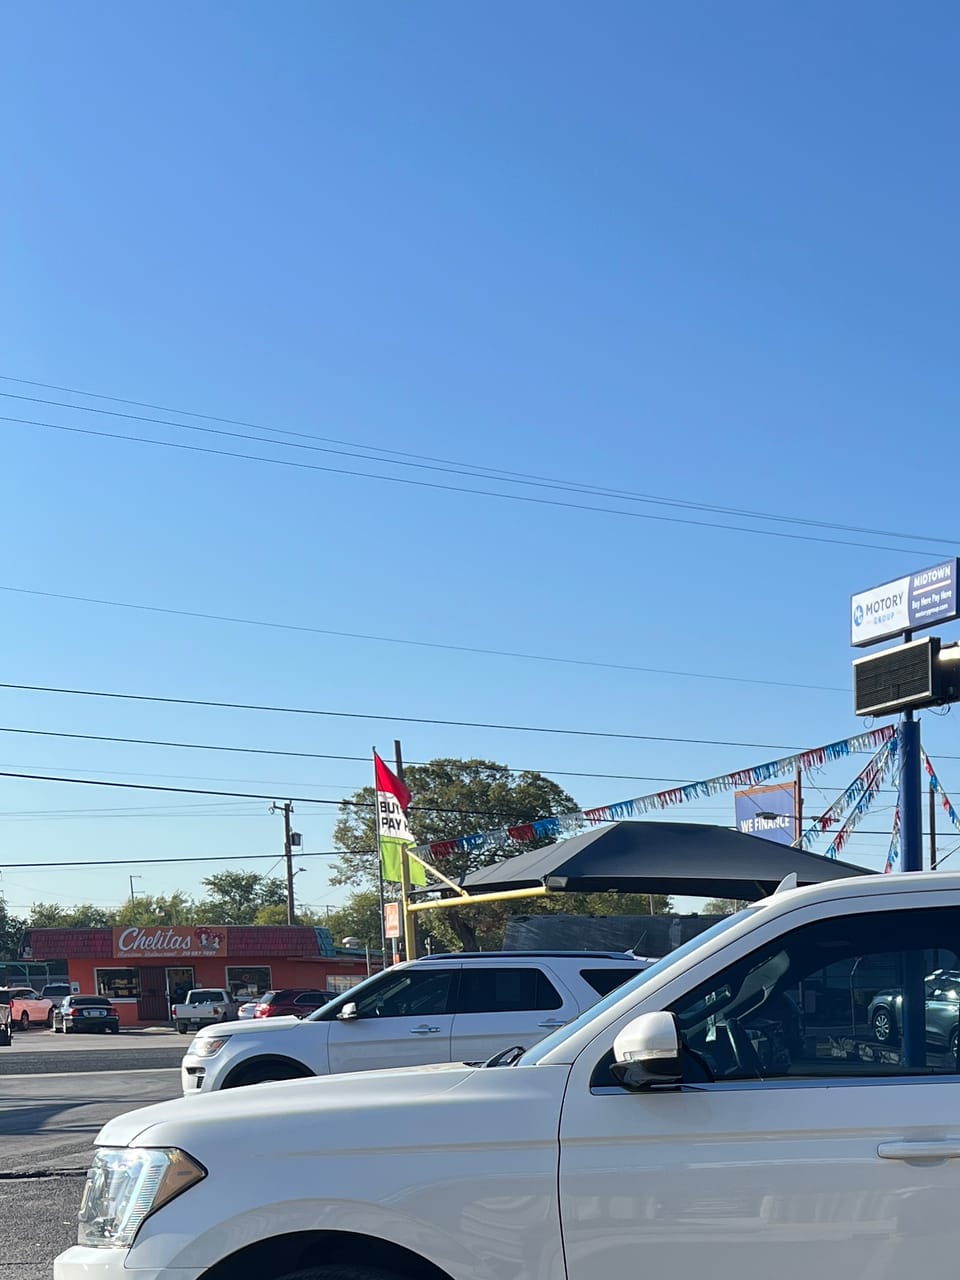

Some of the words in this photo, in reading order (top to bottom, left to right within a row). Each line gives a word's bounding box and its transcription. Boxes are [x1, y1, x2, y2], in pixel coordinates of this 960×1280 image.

[913, 565, 951, 588] MIDTOWN
[865, 592, 904, 616] MOTORY
[873, 611, 895, 625] GROUP
[381, 817, 401, 830] PAY
[741, 819, 753, 833] WE
[754, 814, 790, 831] FINANCE
[118, 927, 192, 951] Chelitas
